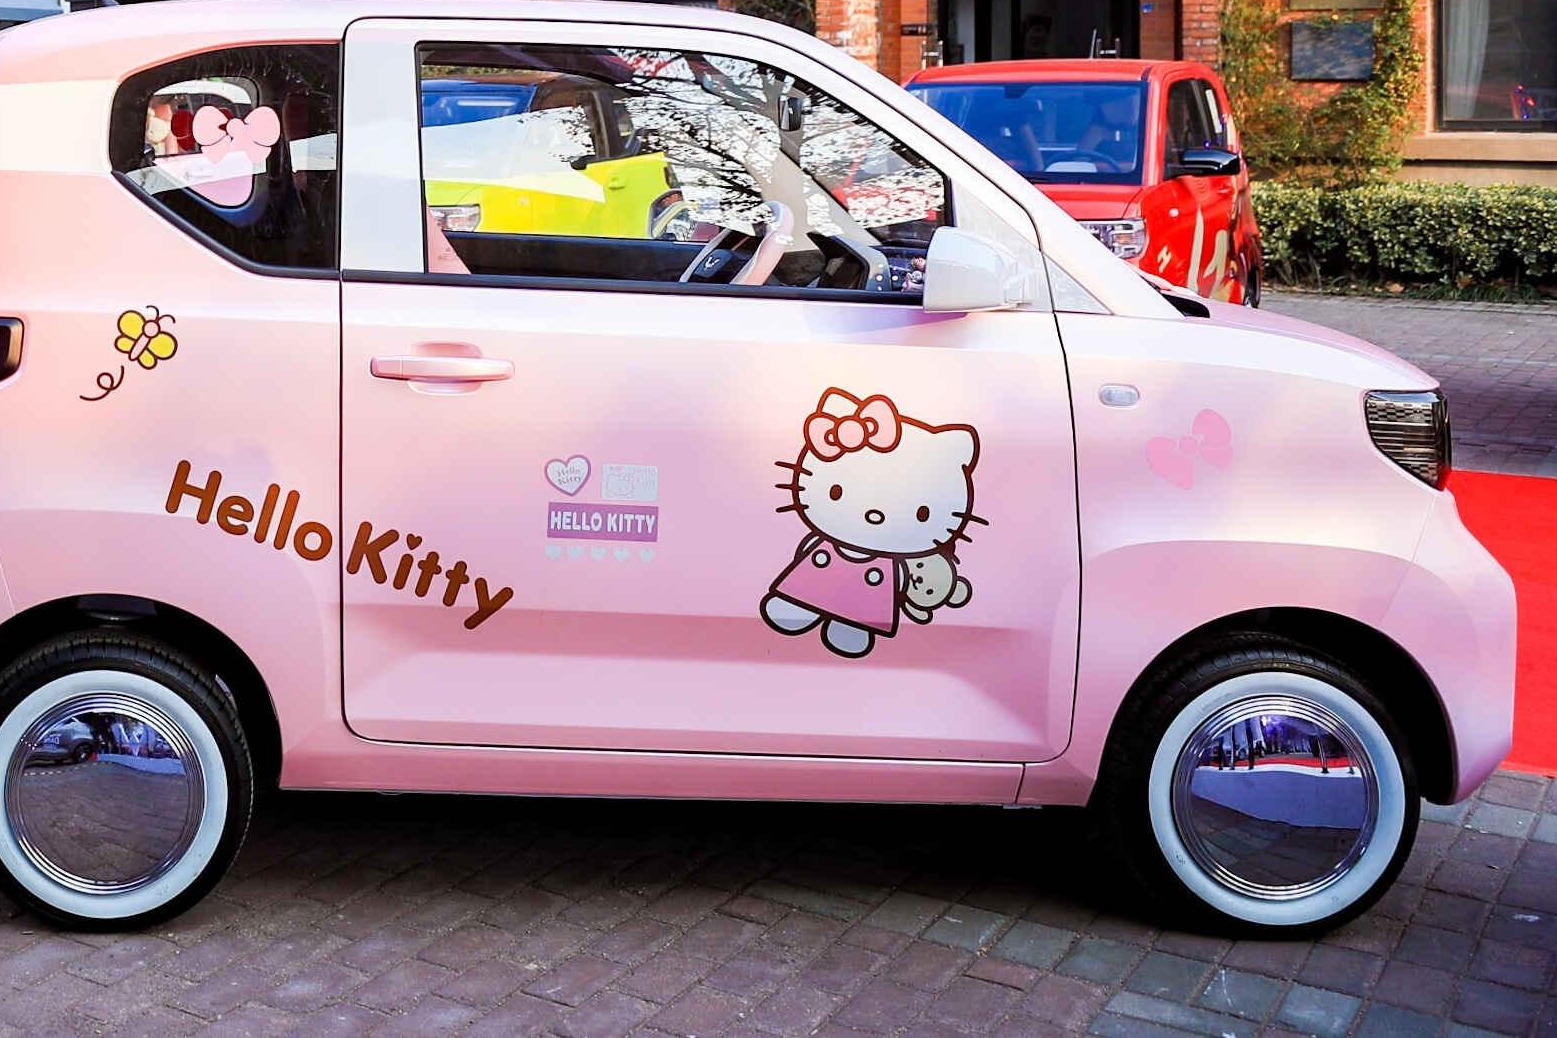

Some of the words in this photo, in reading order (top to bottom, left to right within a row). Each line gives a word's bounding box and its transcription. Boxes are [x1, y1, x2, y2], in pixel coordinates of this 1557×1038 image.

[165, 459, 333, 562] Hello
[345, 521, 515, 631] Kitty
[550, 510, 603, 532] HELLO
[606, 512, 656, 534] KITTY
